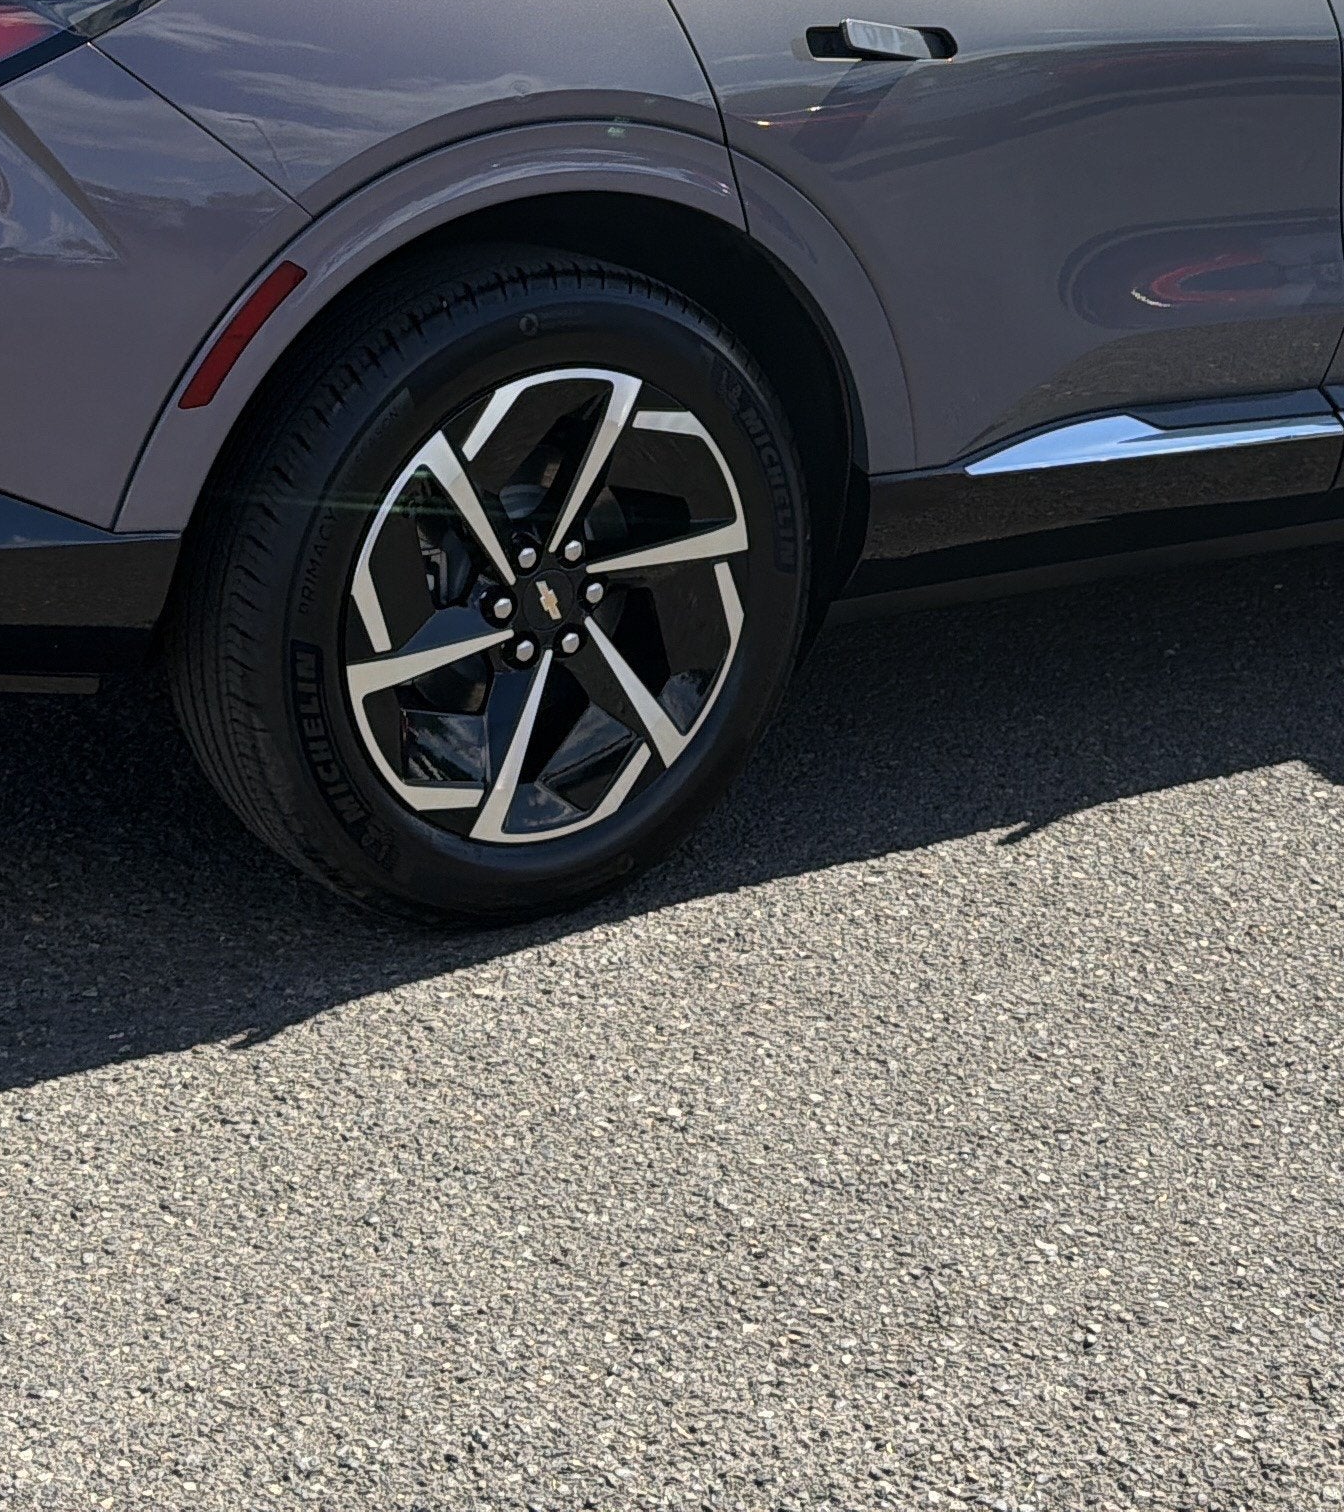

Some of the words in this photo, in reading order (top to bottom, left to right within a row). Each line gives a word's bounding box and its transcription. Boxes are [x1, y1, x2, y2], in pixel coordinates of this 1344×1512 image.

[297, 505, 338, 615] PRIMACY
[739, 405, 797, 565] MICHELIN
[294, 649, 367, 826] MICHELIN
